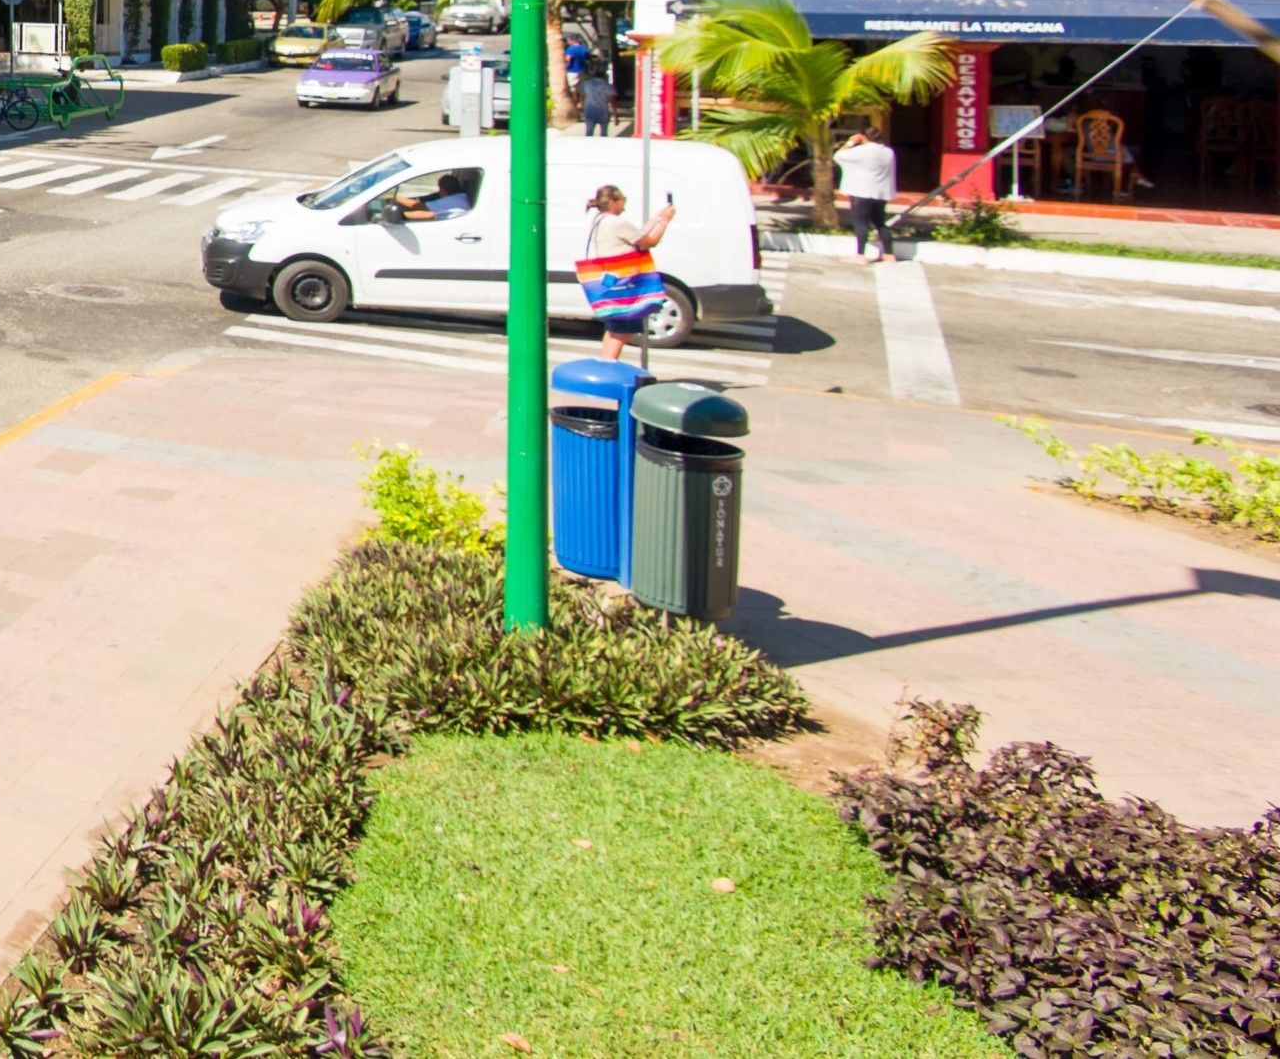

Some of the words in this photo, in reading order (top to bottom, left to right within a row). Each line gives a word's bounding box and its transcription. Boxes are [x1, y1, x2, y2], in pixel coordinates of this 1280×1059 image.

[864, 20, 961, 32] RESTAURANTE
[962, 21, 983, 32] LA
[983, 22, 1065, 34] TROPICANA
[957, 54, 977, 150] DESAYUNOS
